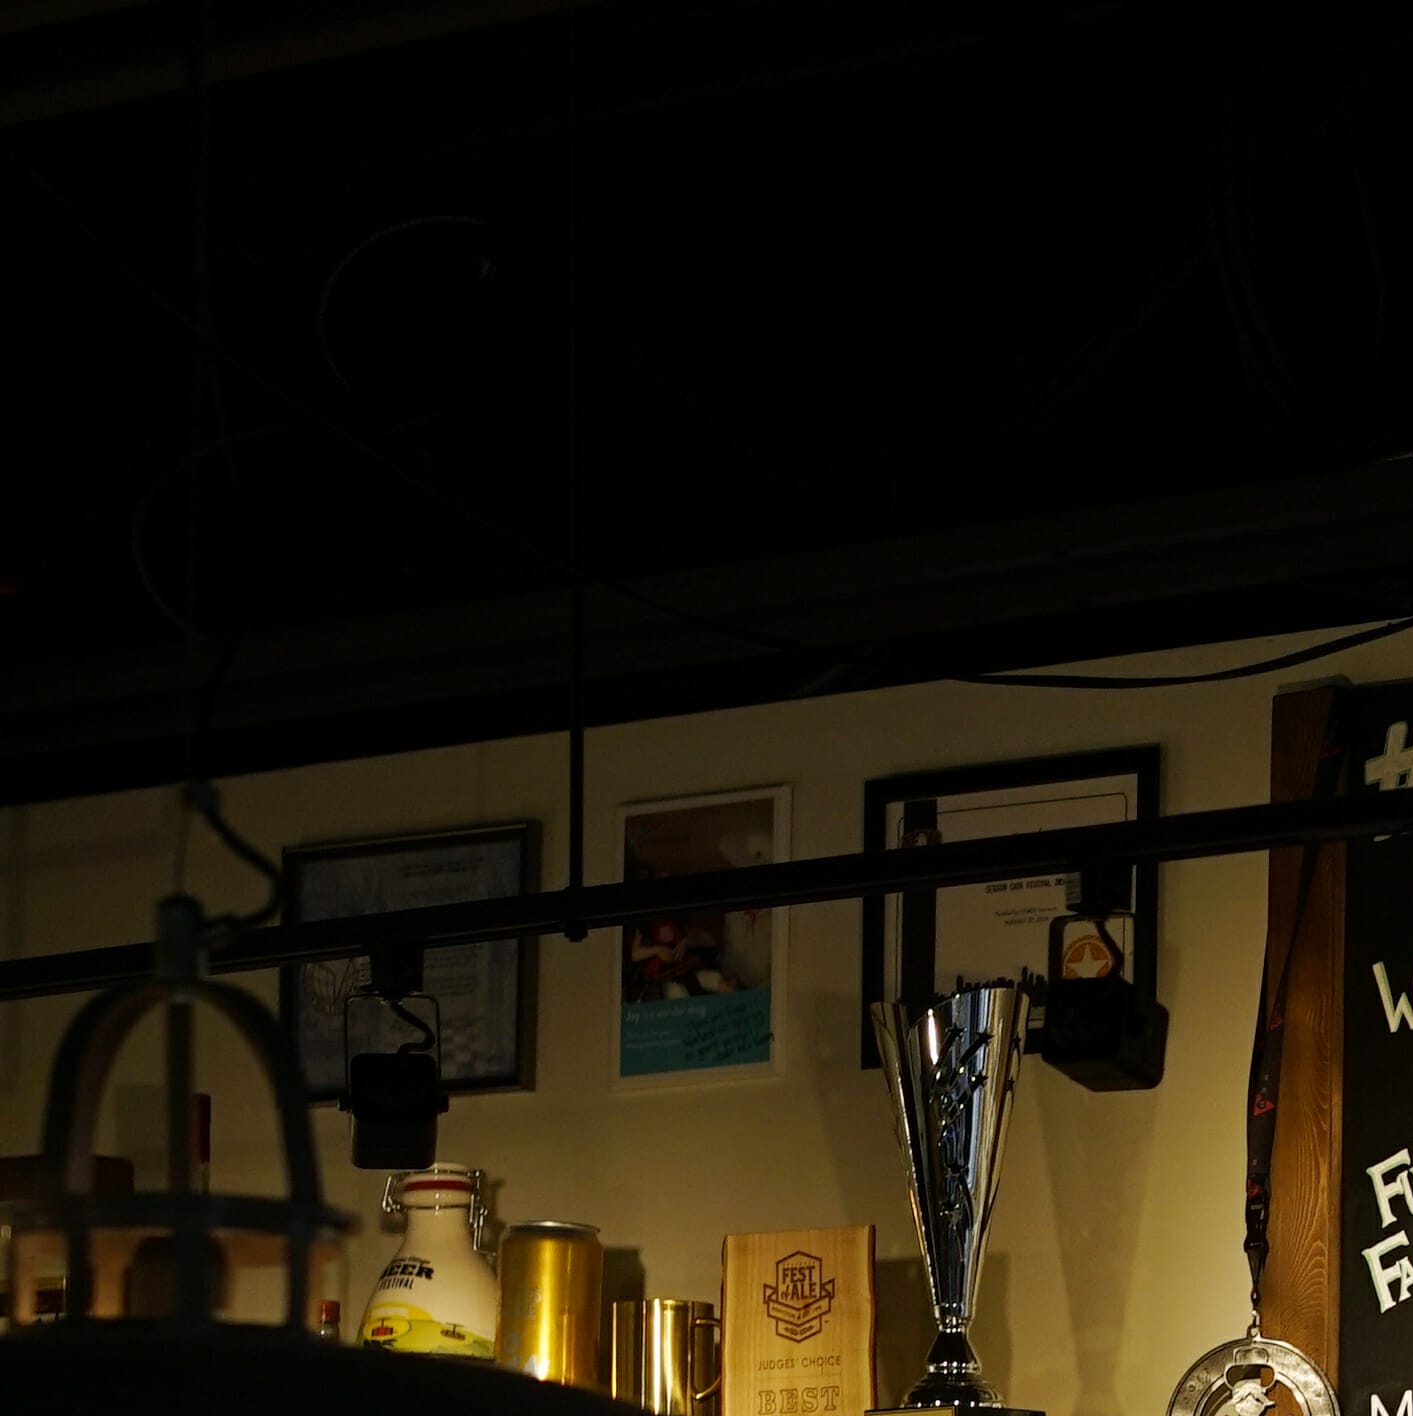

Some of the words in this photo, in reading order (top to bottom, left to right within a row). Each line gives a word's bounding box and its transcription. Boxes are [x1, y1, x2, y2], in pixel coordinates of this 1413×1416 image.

[782, 1265, 816, 1285] FEST
[790, 1282, 817, 1300] ALE
[801, 1355, 841, 1368] CHOICE
[758, 1386, 840, 1415] BEST
